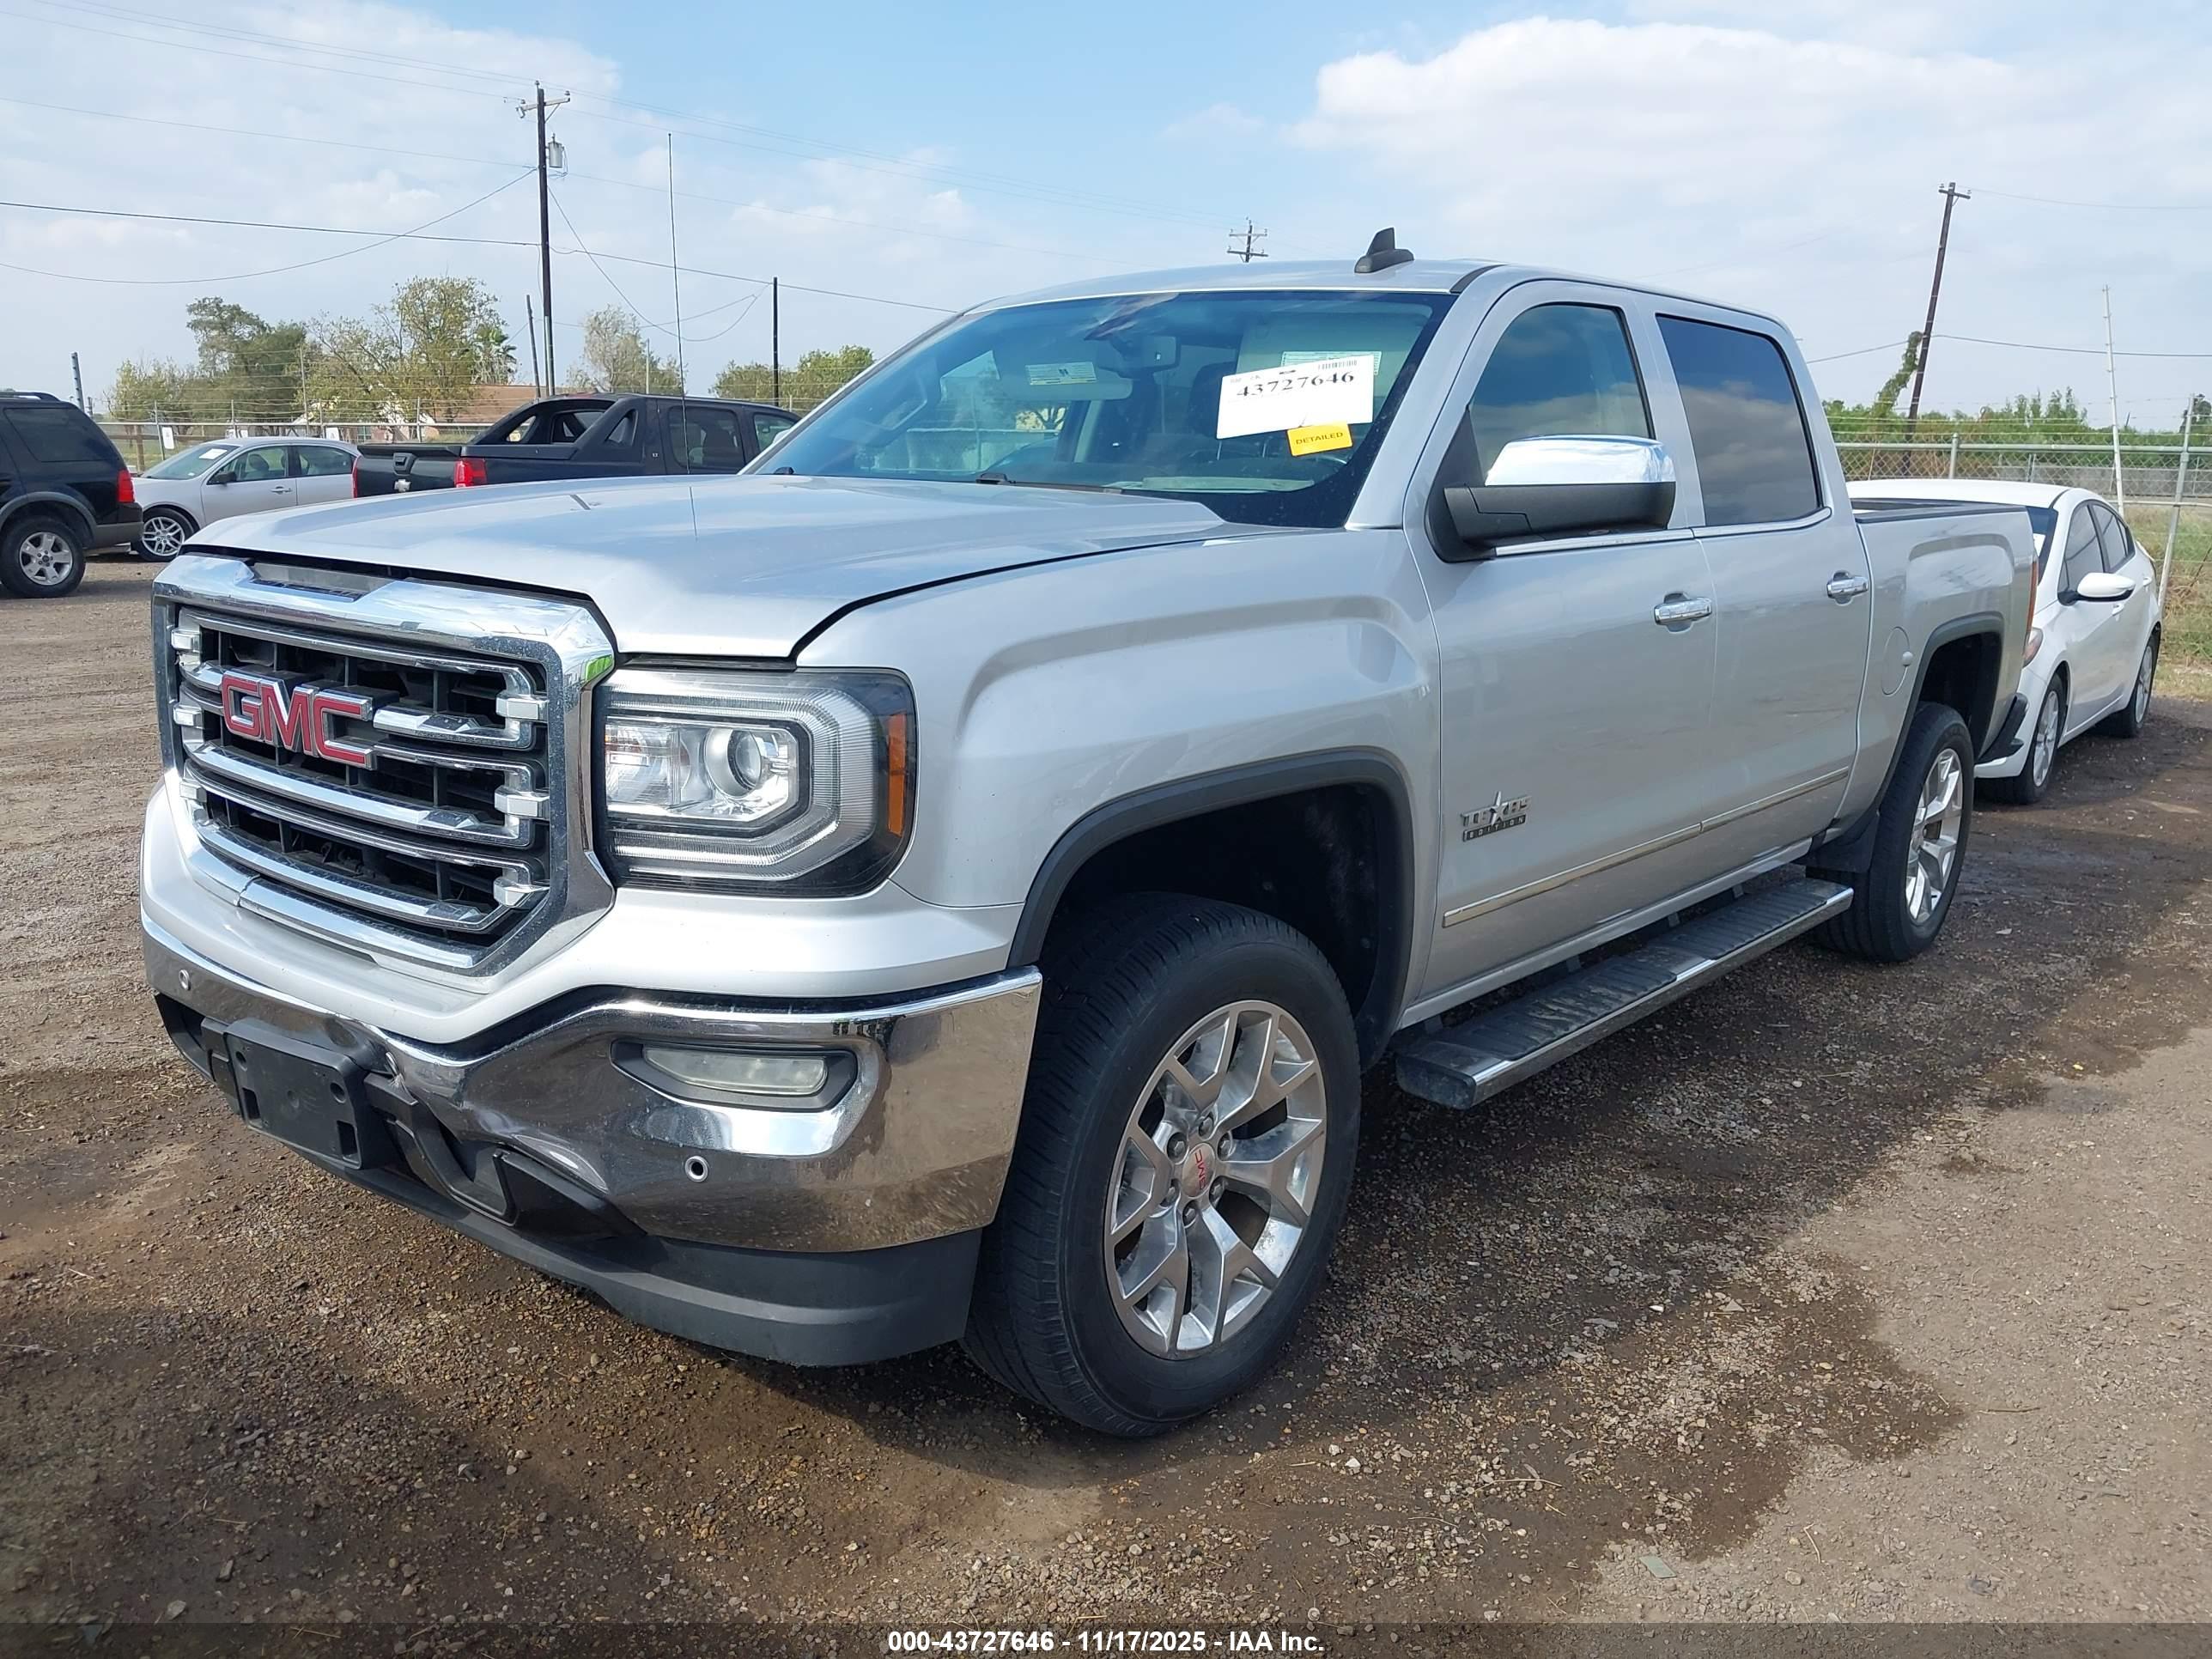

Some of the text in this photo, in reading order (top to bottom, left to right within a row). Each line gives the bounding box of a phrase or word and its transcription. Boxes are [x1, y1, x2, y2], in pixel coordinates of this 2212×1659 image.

[1236, 371, 1354, 397] 43727646
[1295, 432, 1344, 445] DETAILED
[222, 671, 377, 771] GMC
[1460, 791, 1532, 827] TEXAS
[1463, 815, 1526, 841] EDITION
[1194, 1149, 1206, 1191] GMC
